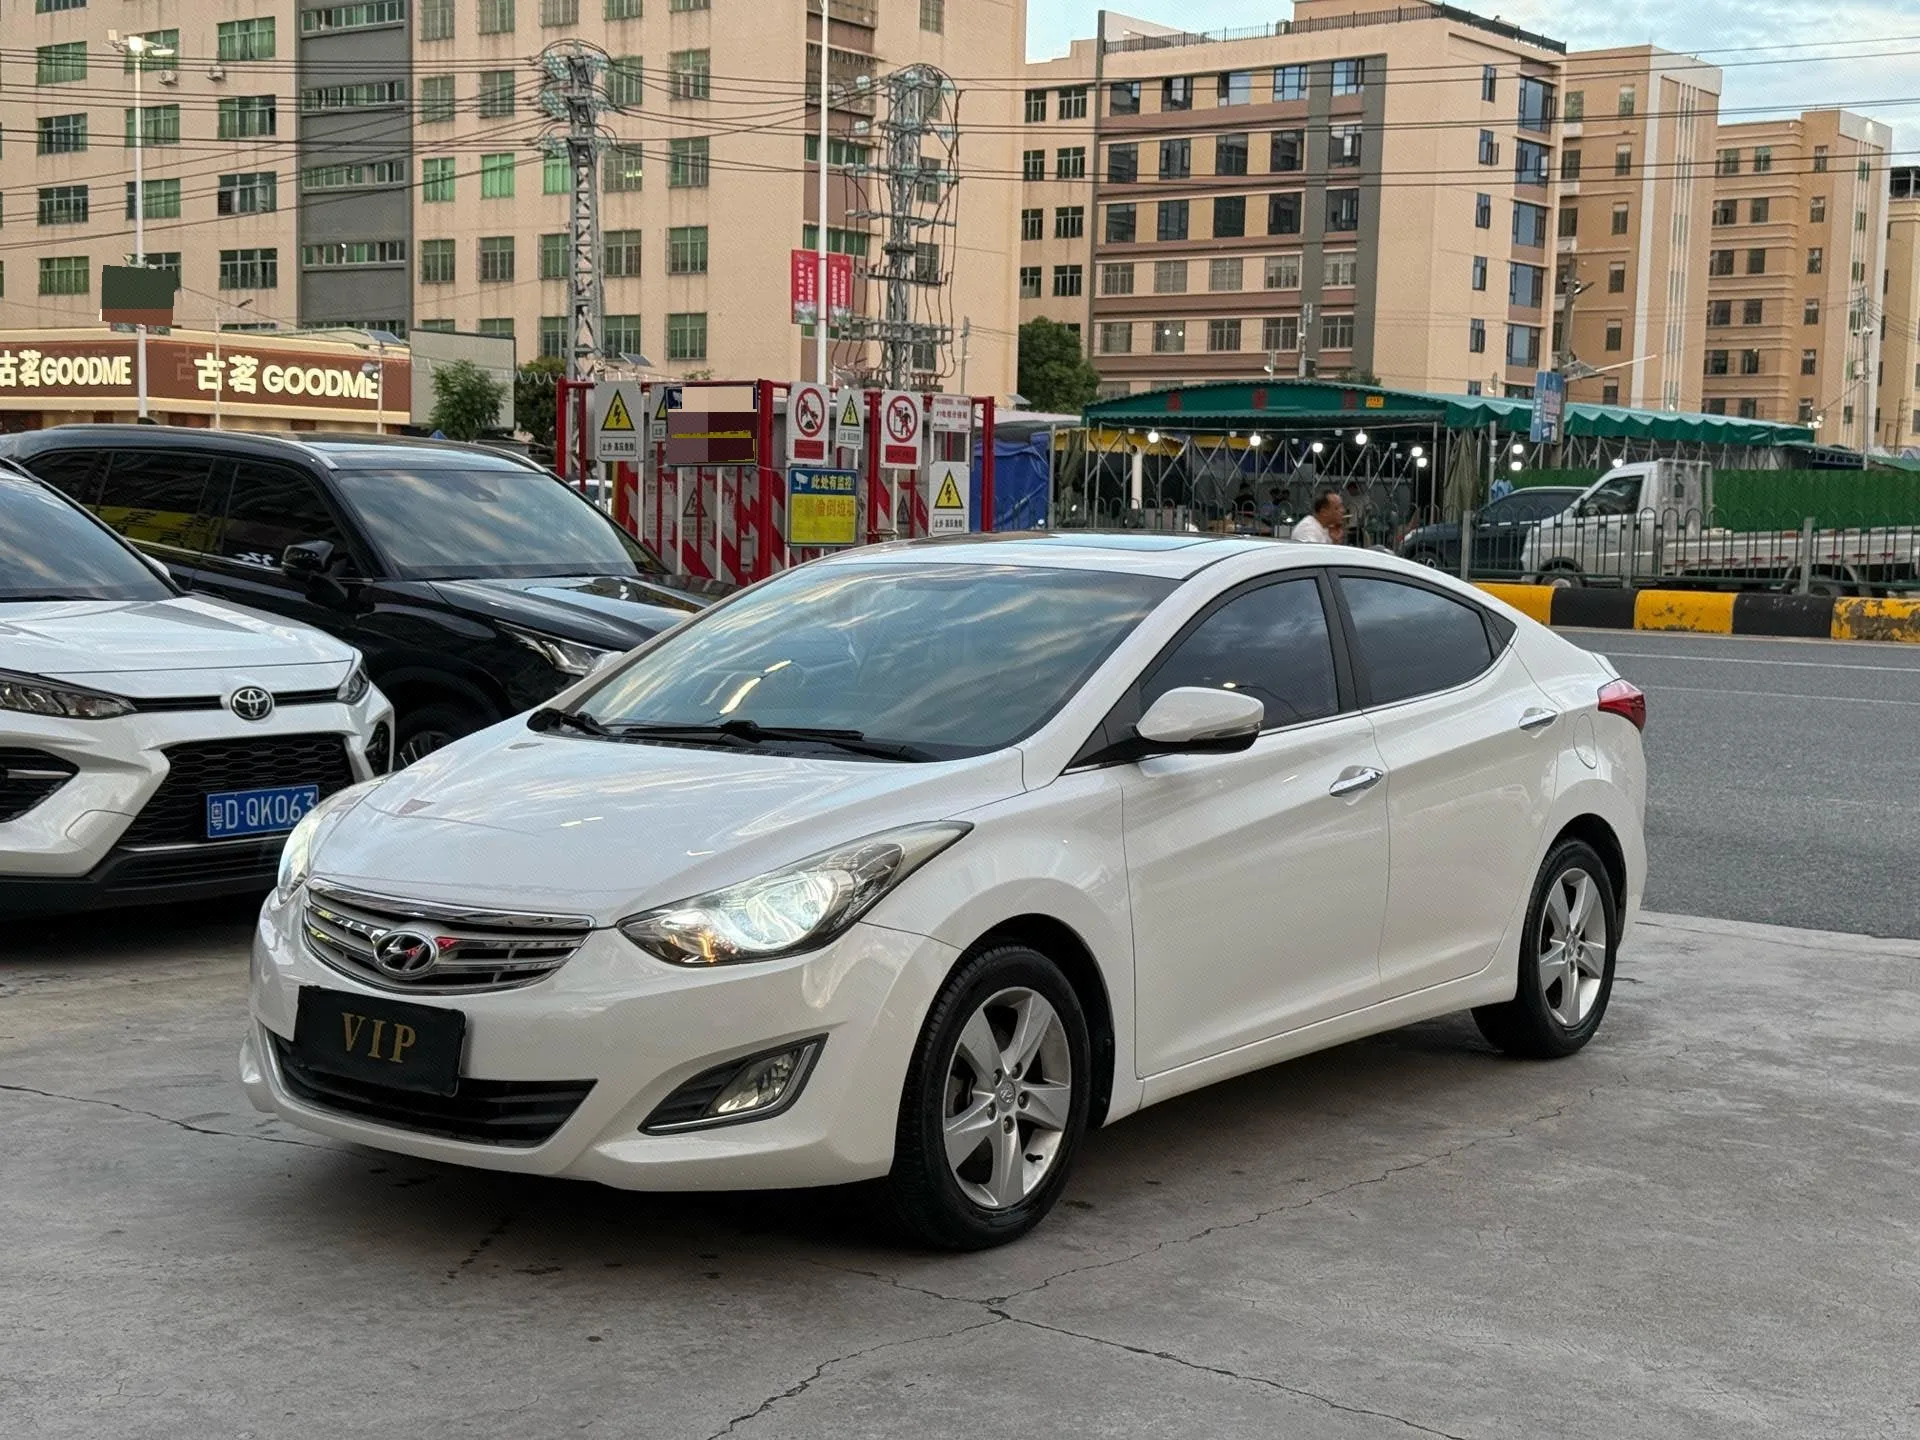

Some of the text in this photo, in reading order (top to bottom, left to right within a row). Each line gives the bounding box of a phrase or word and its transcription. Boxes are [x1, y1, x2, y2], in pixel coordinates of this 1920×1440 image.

[0, 350, 132, 387] 古茗 GOODME
[194, 352, 379, 399] 古茗 GOODME
[341, 1012, 416, 1063] VIP
